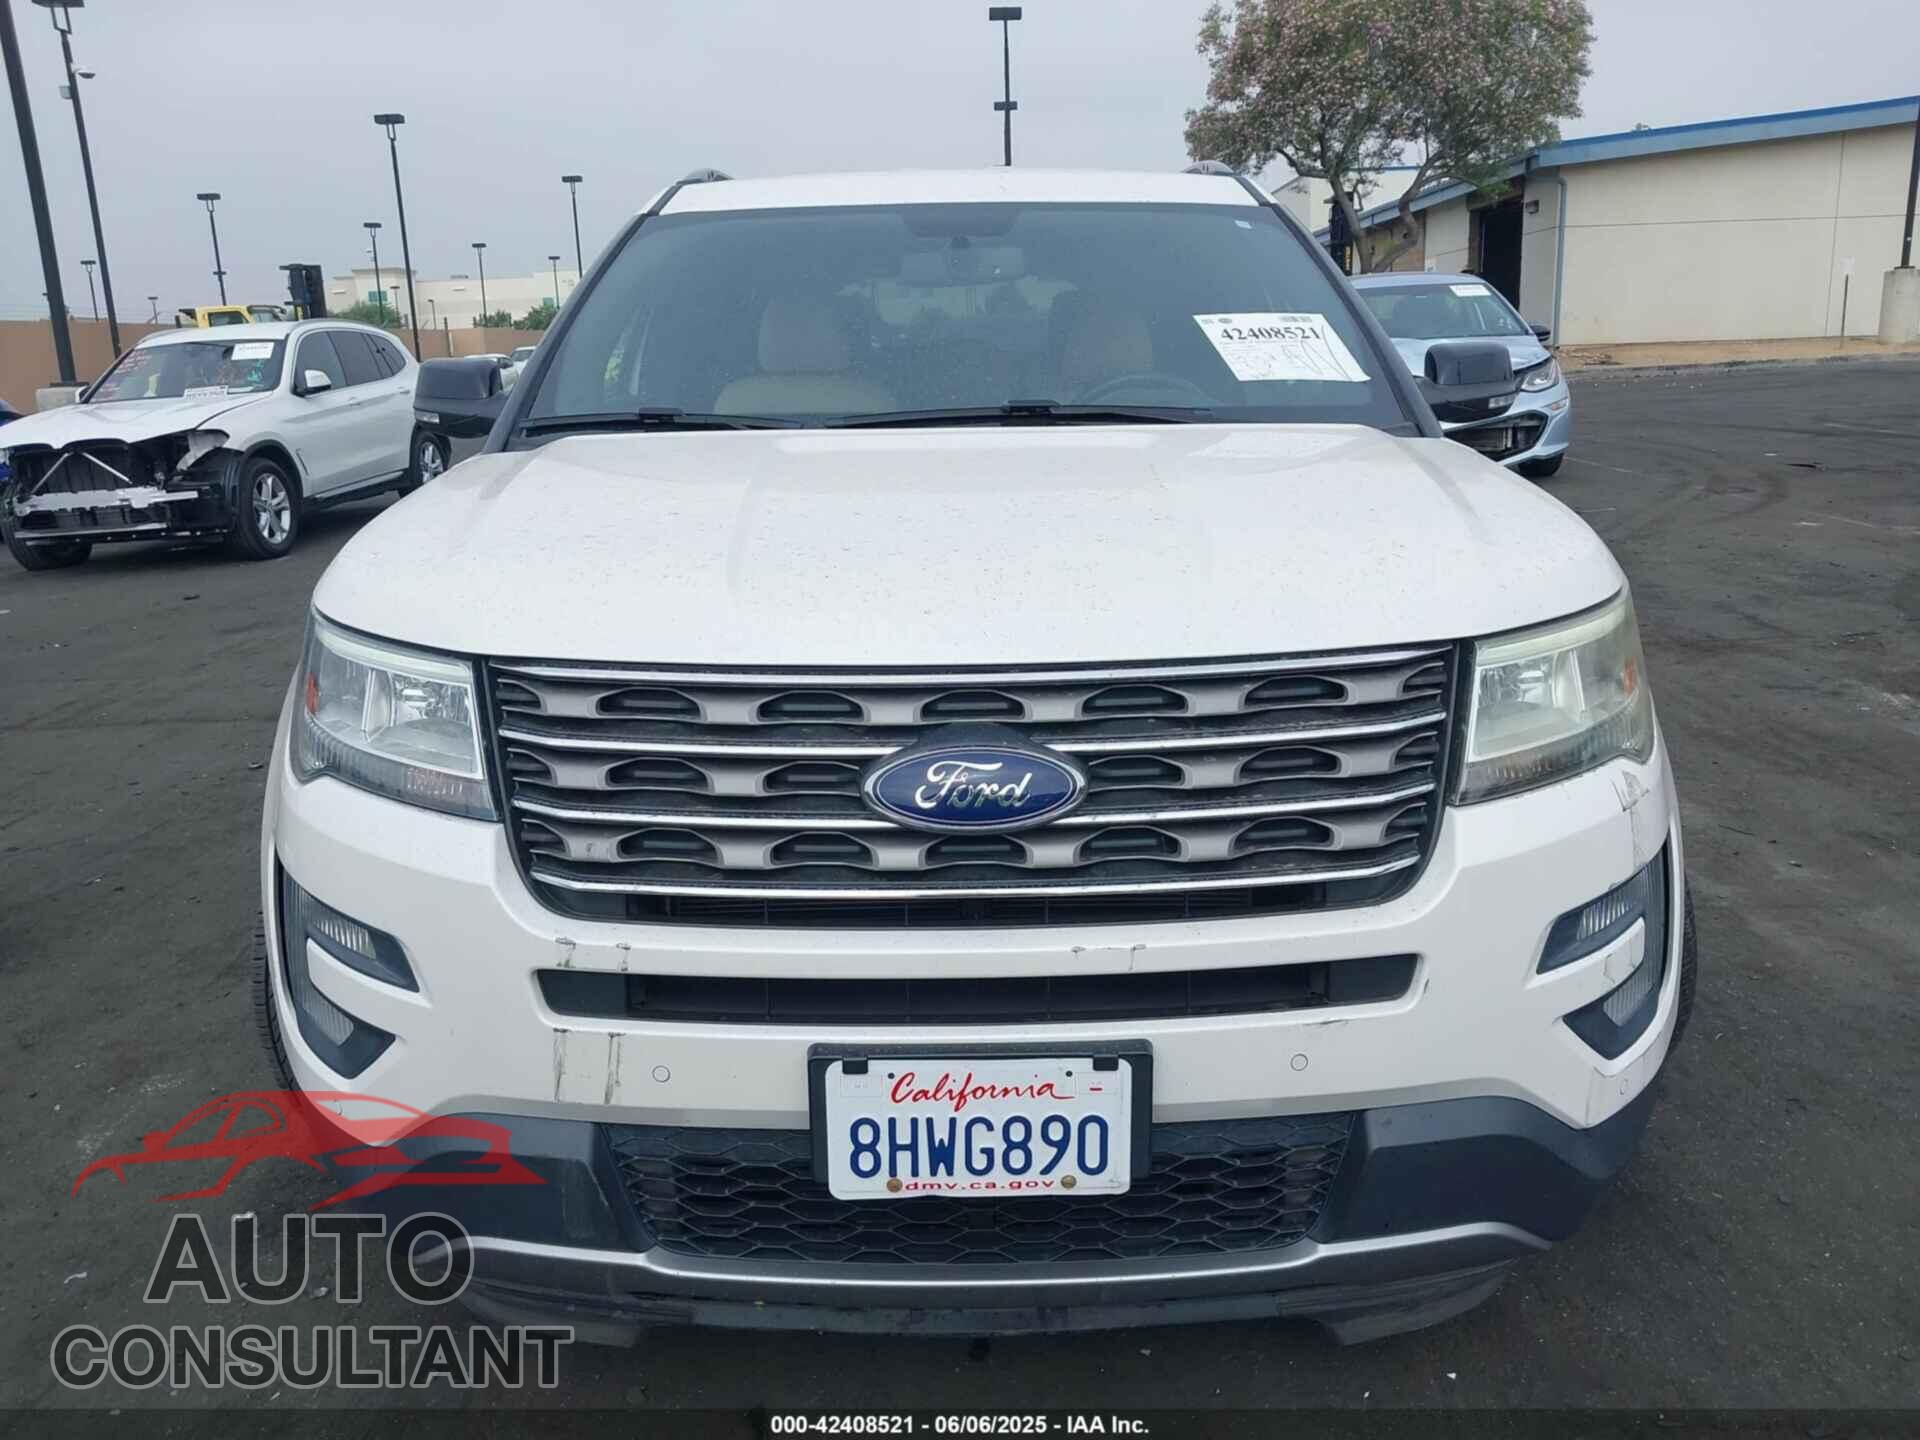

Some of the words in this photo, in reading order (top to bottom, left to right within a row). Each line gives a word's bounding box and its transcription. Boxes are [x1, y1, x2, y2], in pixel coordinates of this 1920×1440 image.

[1221, 326, 1320, 341] 42408521
[914, 760, 1033, 809] Ford
[890, 1071, 1075, 1113] California
[849, 1114, 1109, 1179] 8HWG890
[904, 1178, 1055, 1191] dmv.ca.gov
